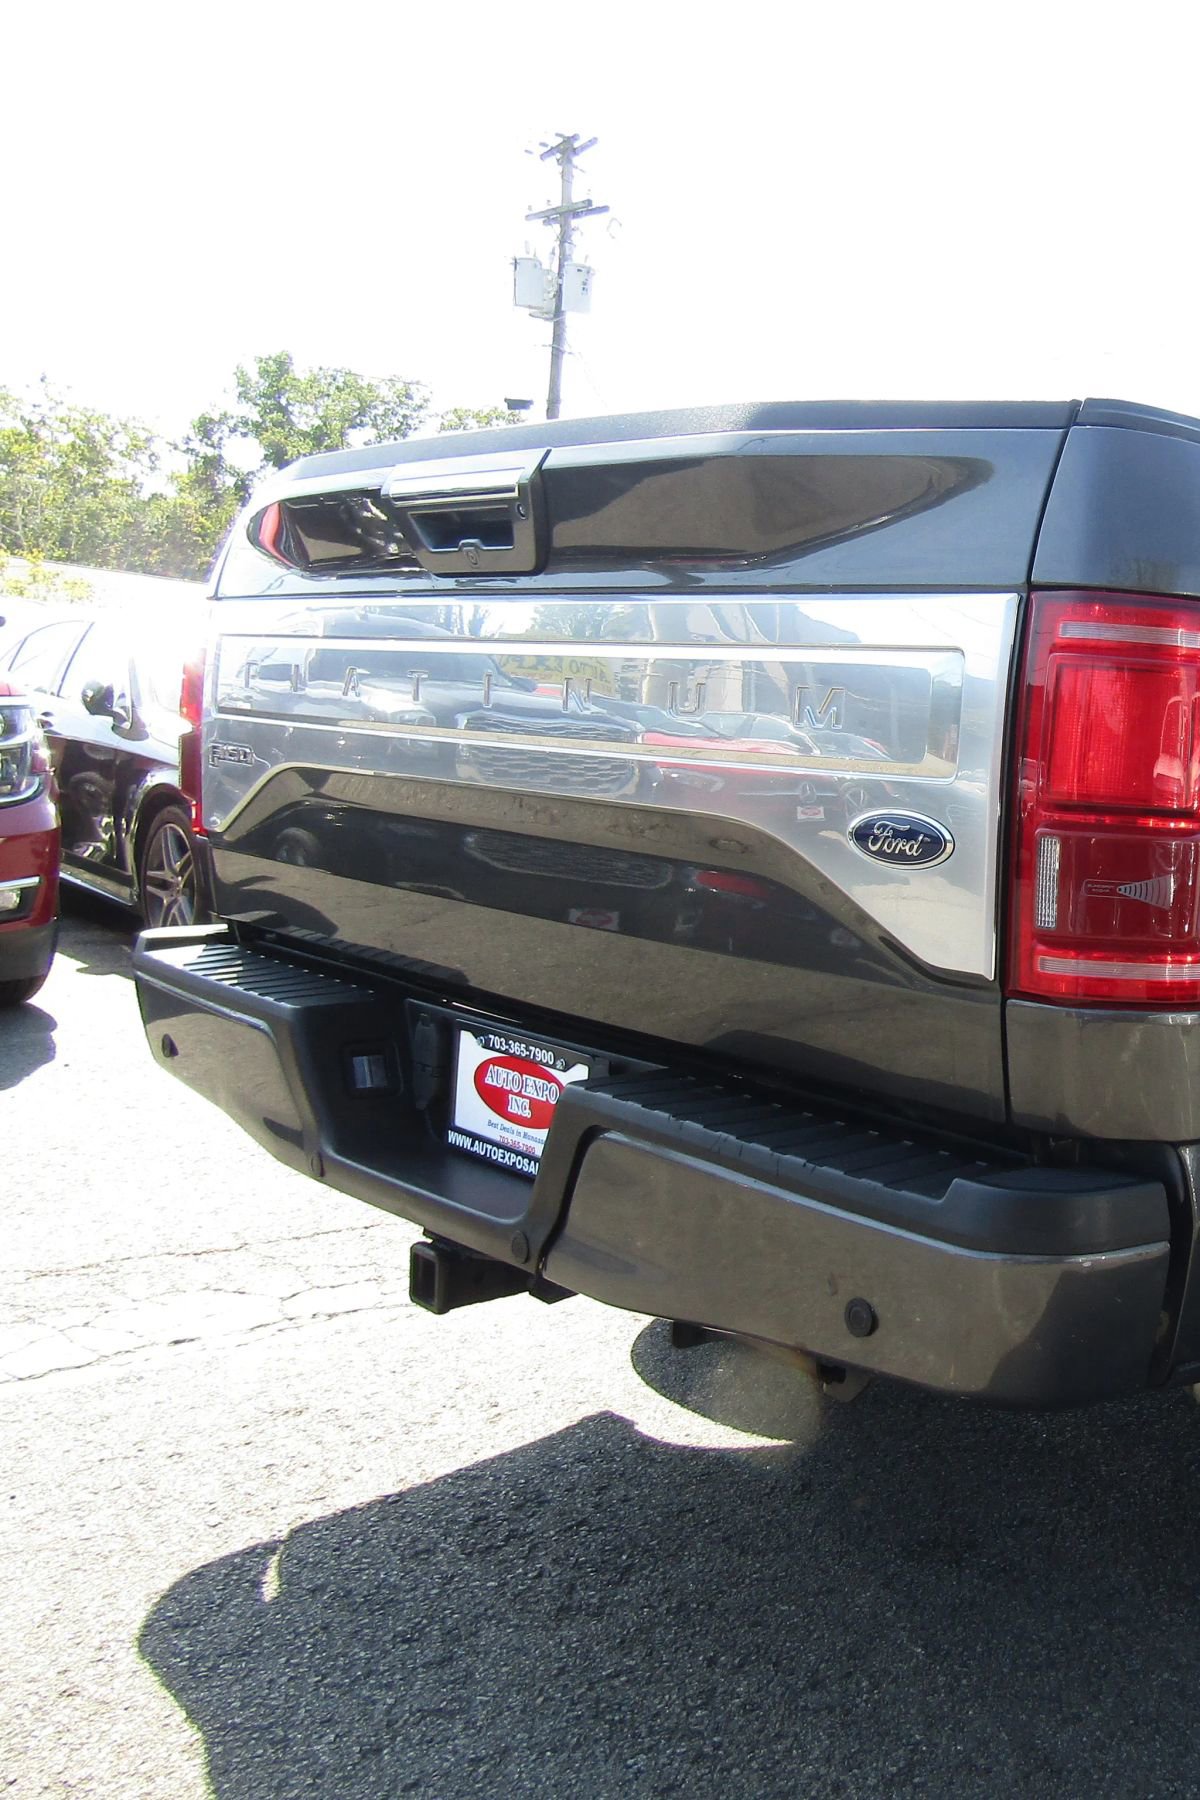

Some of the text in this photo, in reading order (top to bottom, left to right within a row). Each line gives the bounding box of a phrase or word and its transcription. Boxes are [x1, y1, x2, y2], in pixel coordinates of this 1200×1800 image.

[868, 820, 930, 857] Ford
[488, 1034, 554, 1066] 703-365-7900
[485, 1064, 560, 1104] AUTO EXPO
[508, 1095, 532, 1118] INC.
[487, 1119, 499, 1130] Best
[500, 1123, 515, 1135] Deals
[499, 1135, 536, 1155] 703-365-7900
